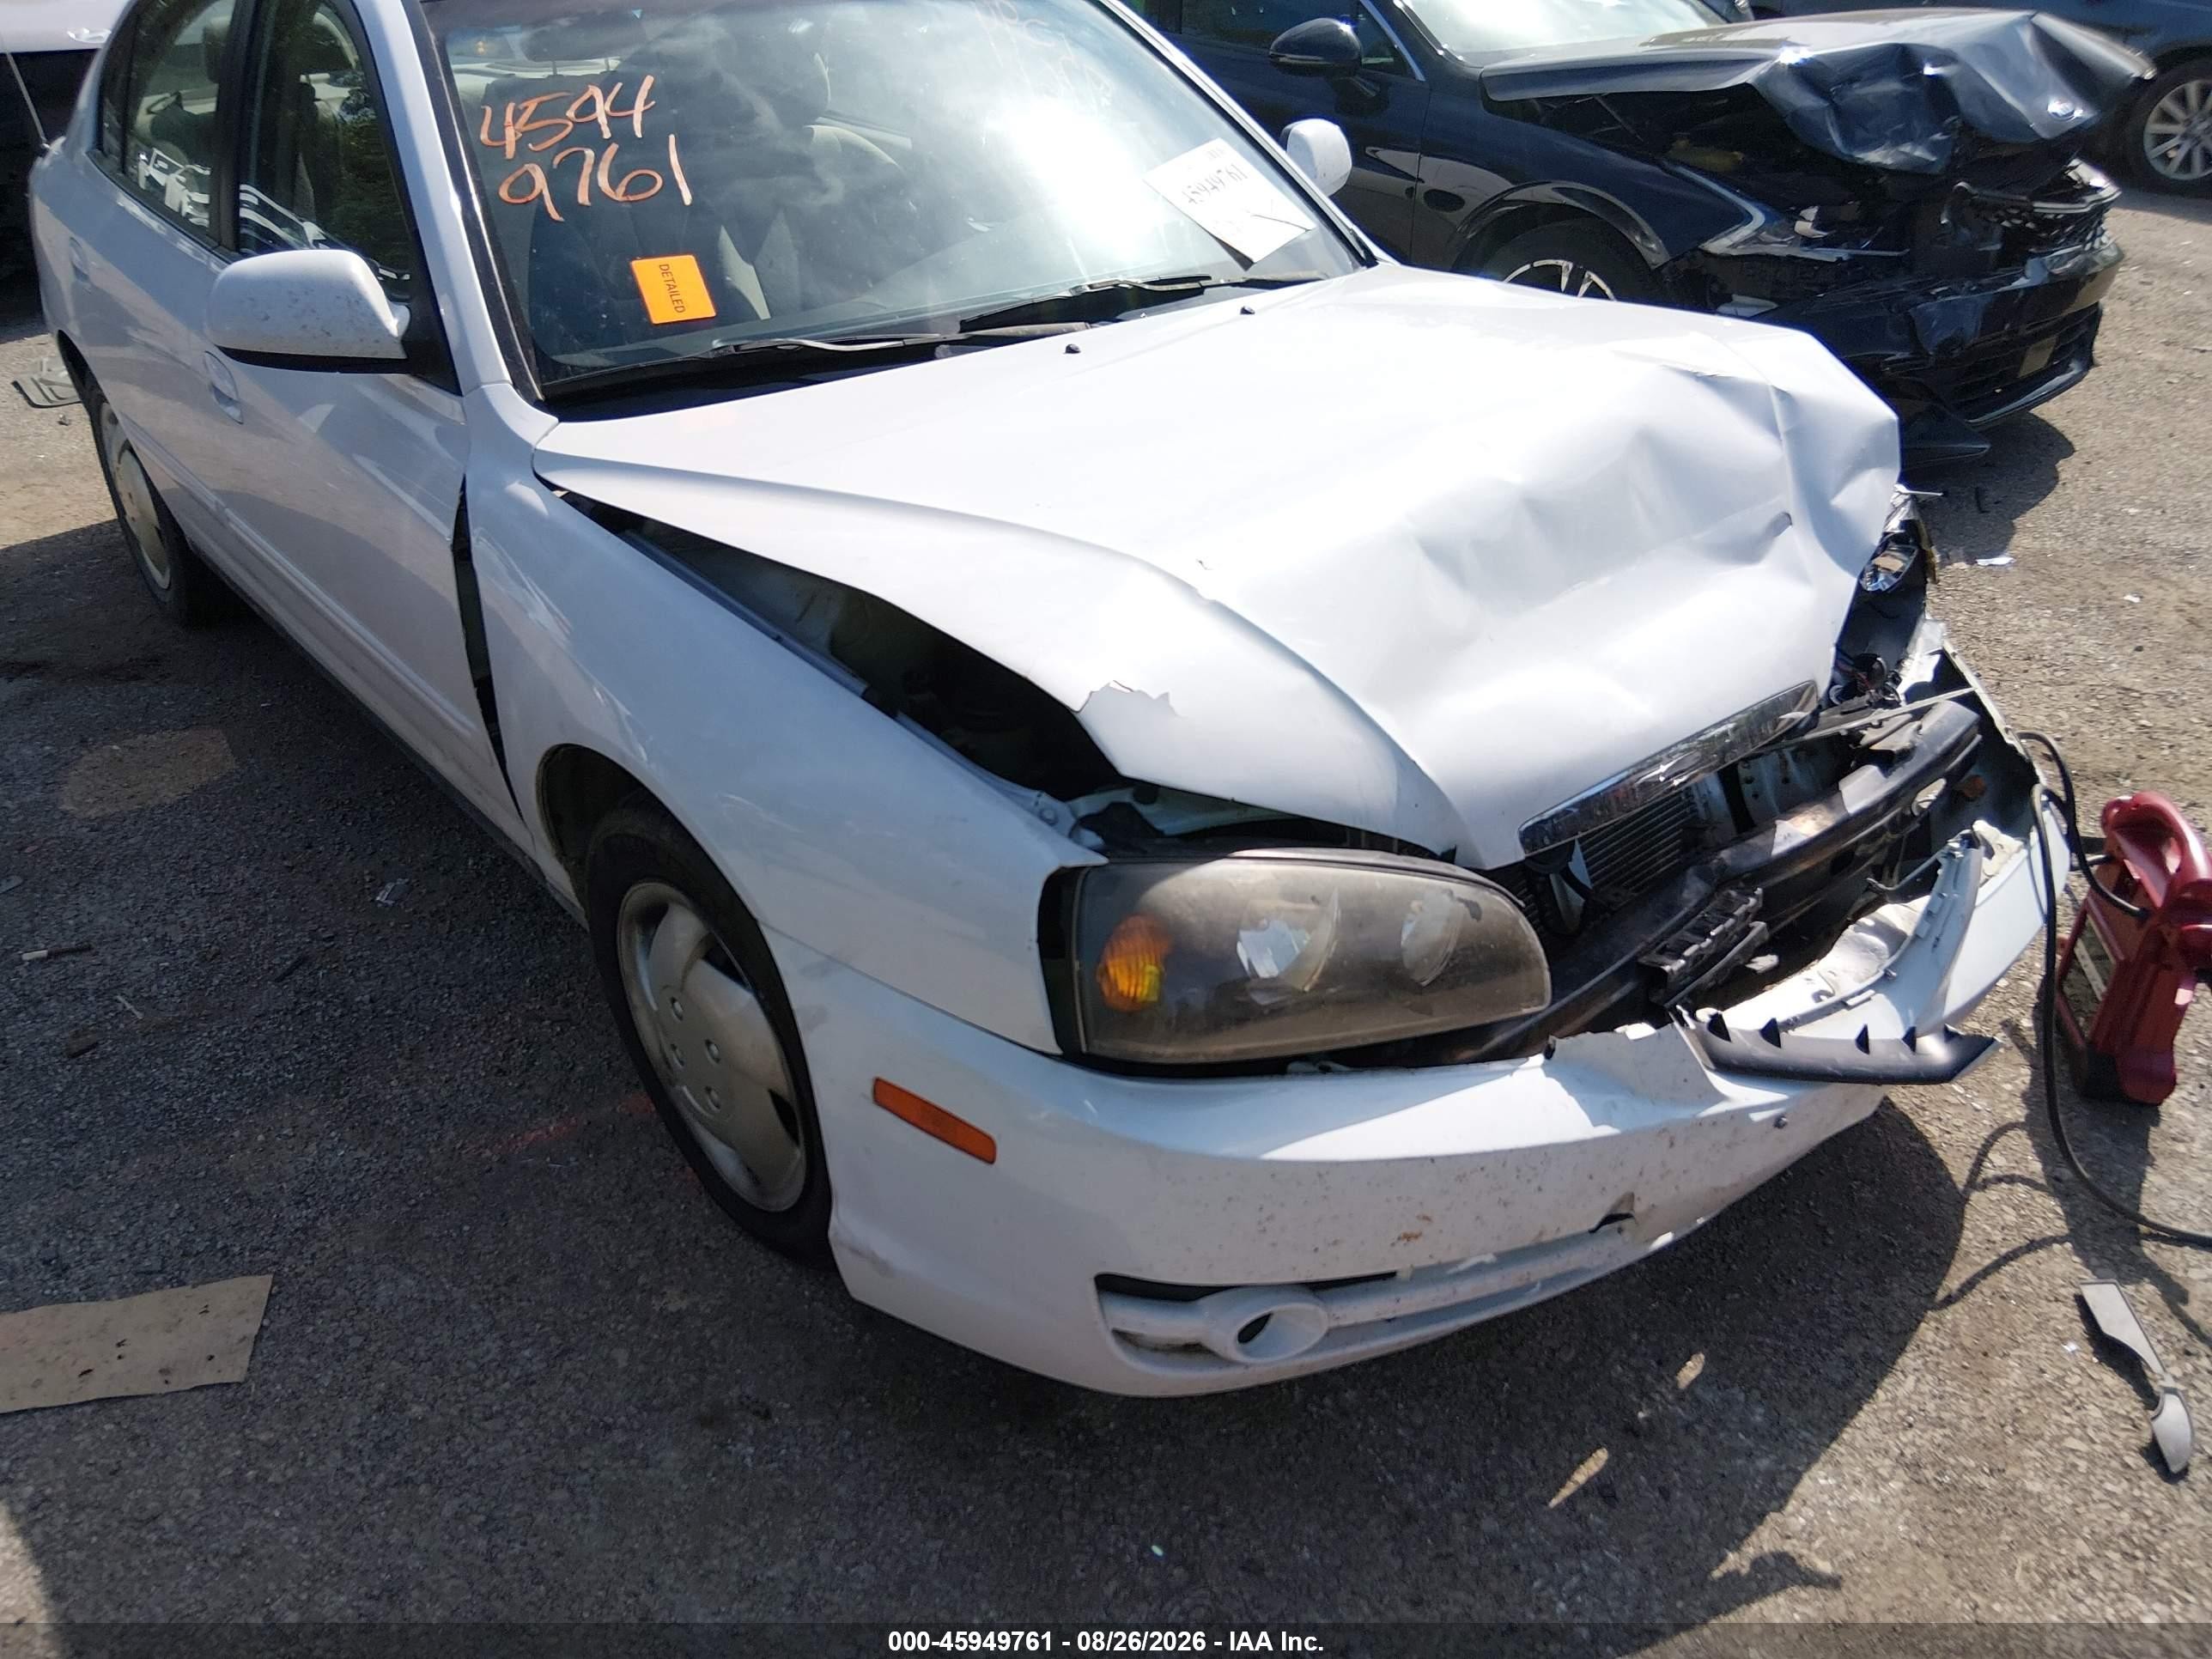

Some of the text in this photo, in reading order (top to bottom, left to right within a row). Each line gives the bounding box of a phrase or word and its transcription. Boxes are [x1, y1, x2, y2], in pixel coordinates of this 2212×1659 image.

[480, 75, 656, 160] 4594
[498, 134, 692, 222] 9761
[1182, 163, 1249, 204] 4594961
[659, 264, 686, 313] DETAILED
